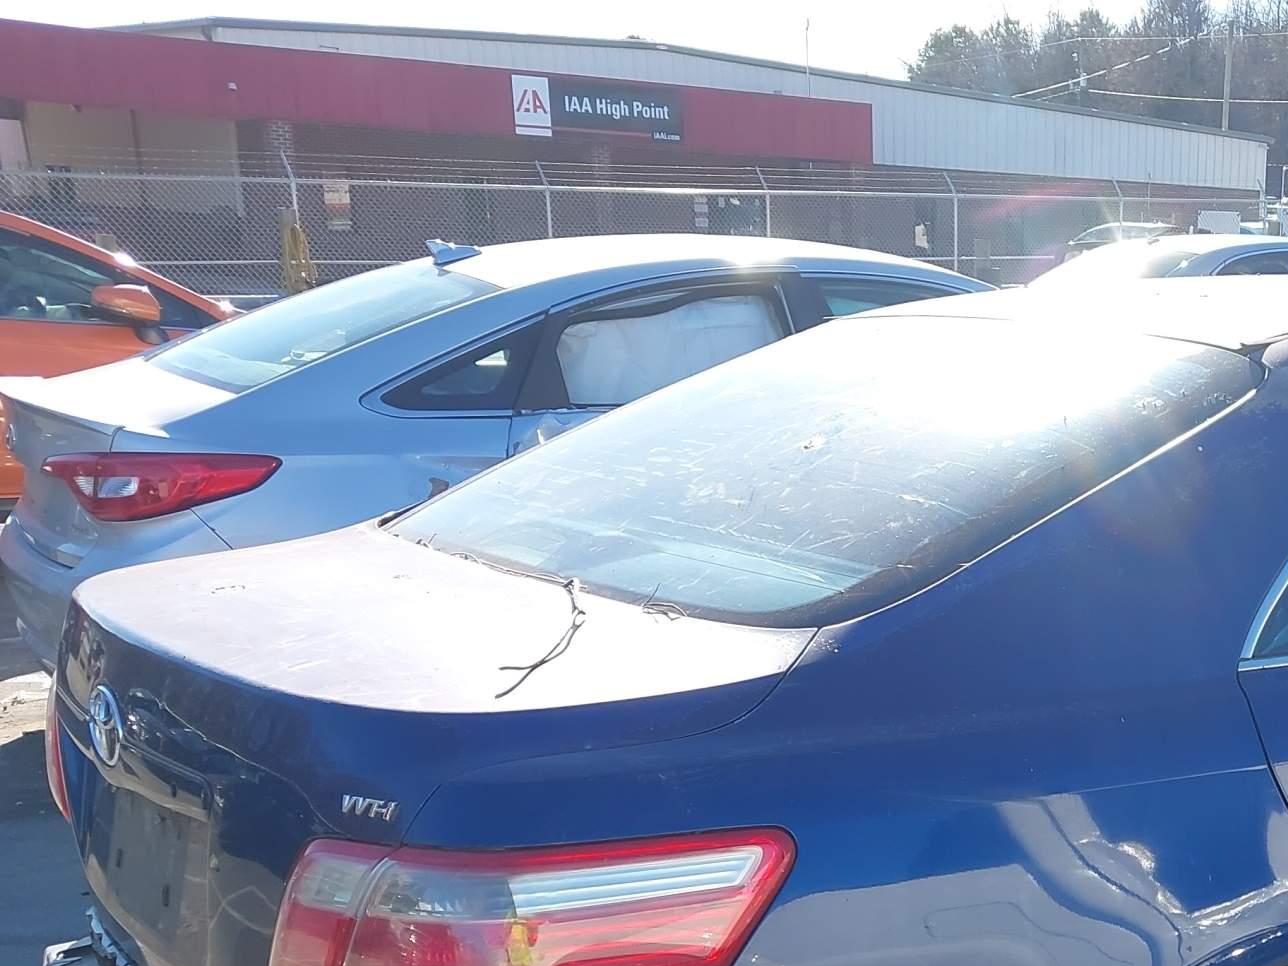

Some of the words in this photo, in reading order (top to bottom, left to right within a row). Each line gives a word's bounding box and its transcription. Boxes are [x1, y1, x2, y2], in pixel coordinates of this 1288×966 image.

[564, 95, 593, 114] IAA
[596, 98, 630, 120] High
[633, 101, 670, 120] Point
